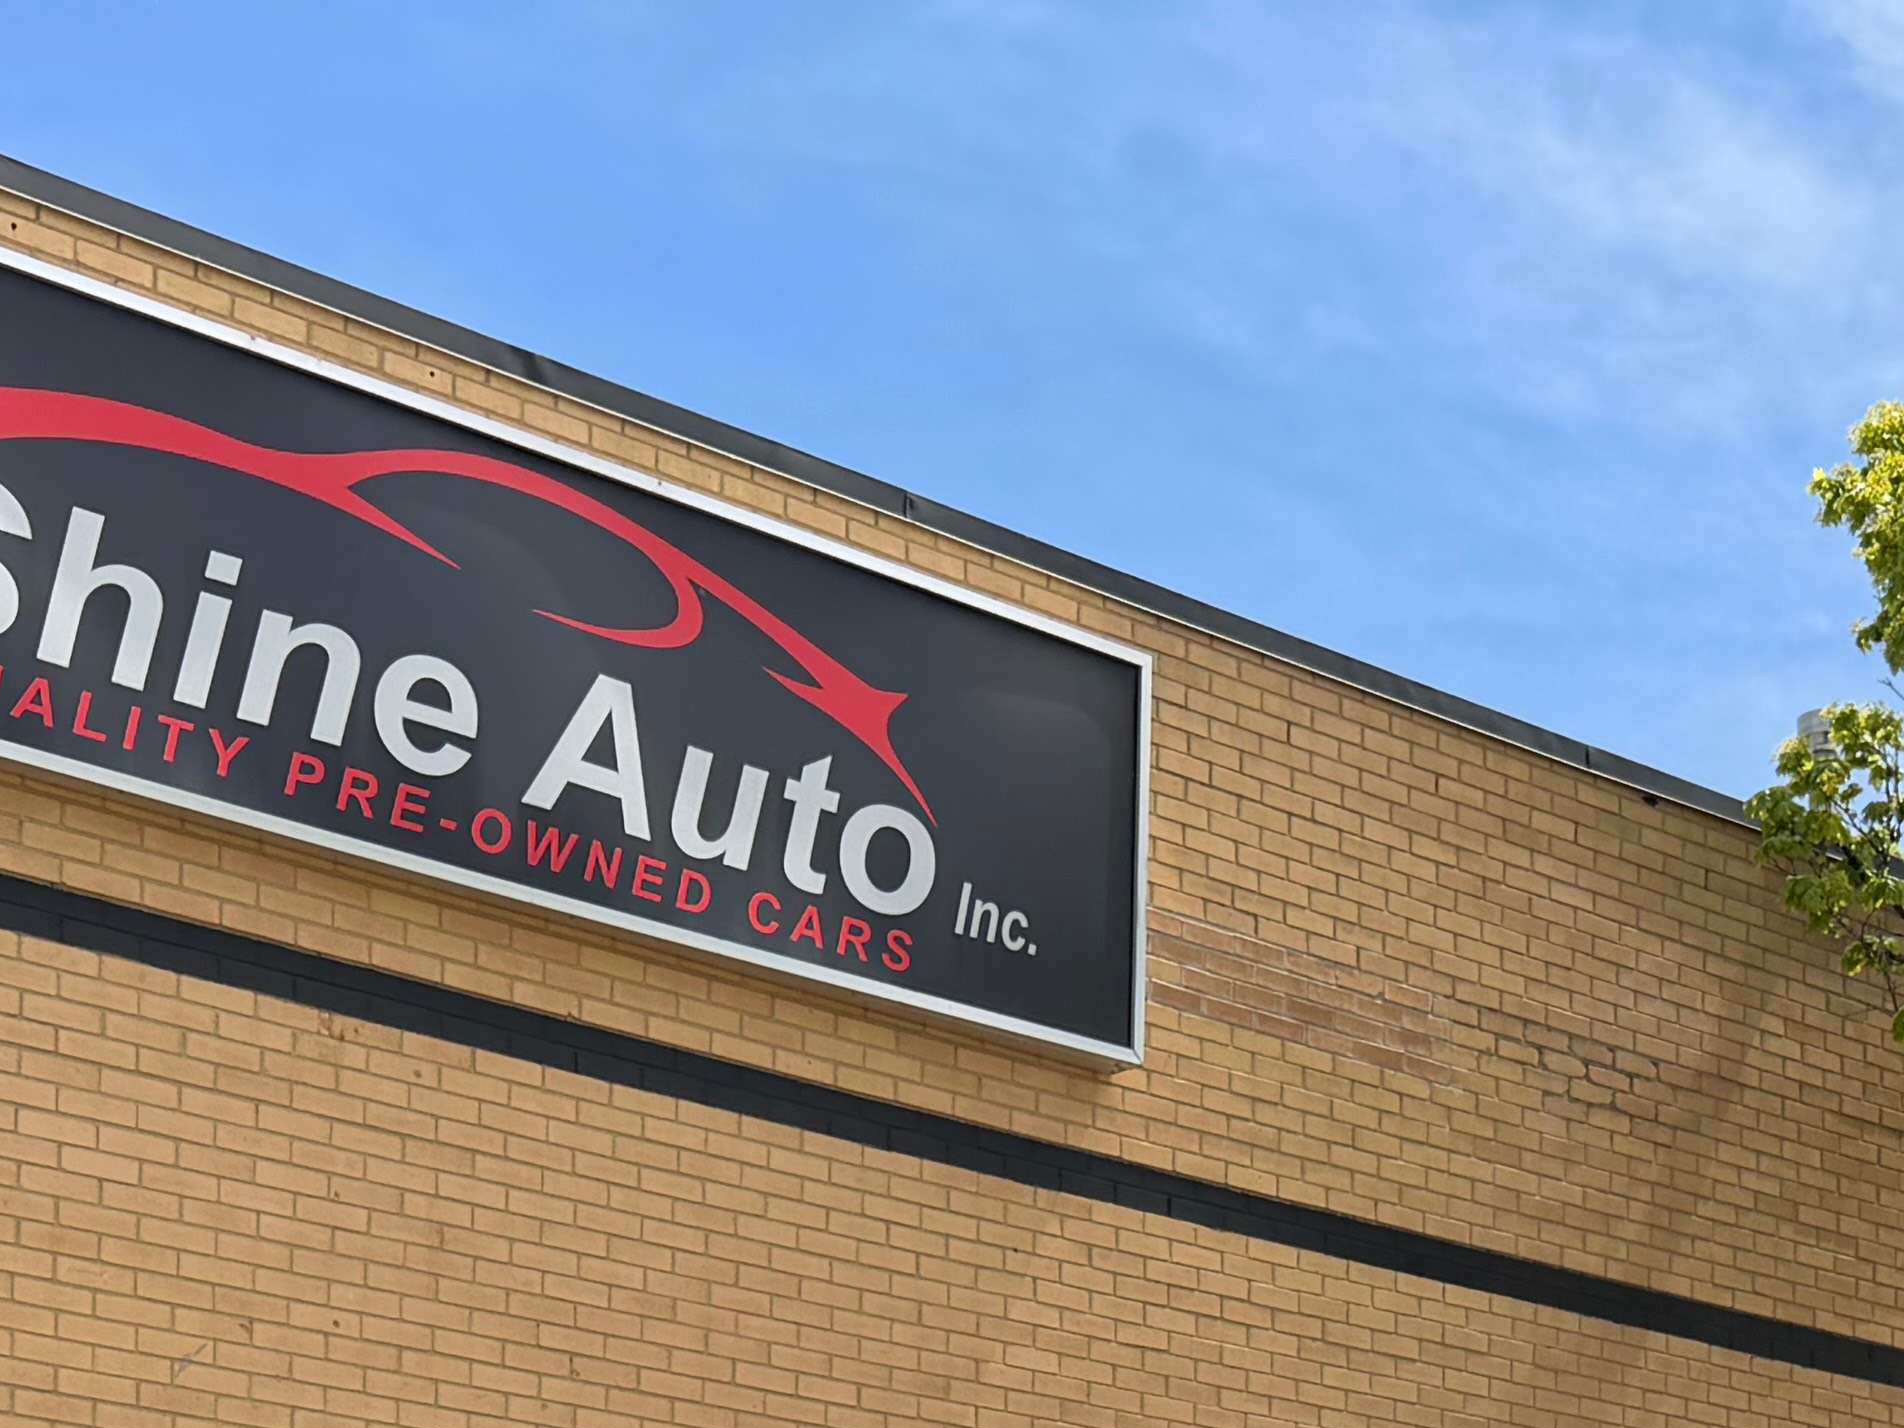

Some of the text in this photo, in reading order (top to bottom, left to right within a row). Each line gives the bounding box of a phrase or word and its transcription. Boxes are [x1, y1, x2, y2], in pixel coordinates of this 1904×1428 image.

[283, 751, 713, 913] PRE-OWNED
[747, 891, 913, 972] CARS
[521, 673, 936, 915] Auto
[954, 882, 1038, 955] Inc.
